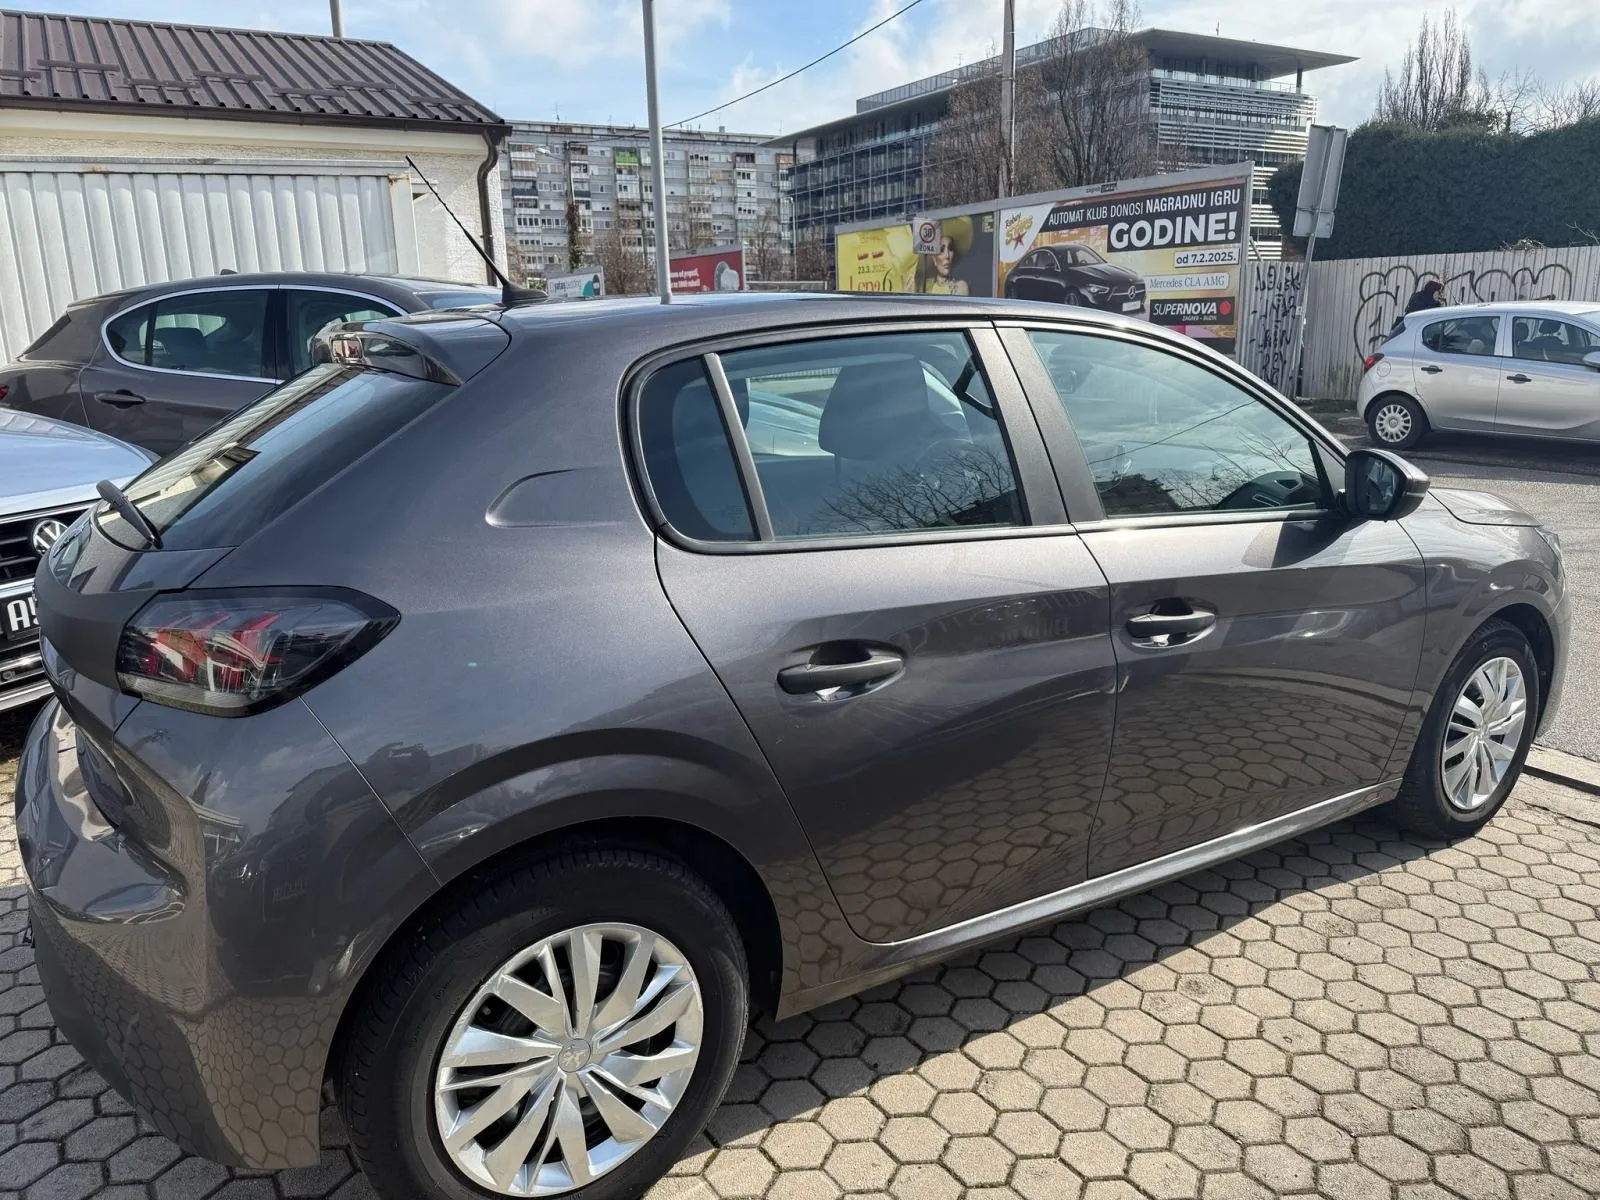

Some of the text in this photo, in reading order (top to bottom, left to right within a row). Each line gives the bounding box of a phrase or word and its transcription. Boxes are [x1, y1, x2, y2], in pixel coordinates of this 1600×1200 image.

[1048, 188, 1241, 226] AUTOMAT KLUB DONOSI NAGRADNU IGRU
[923, 228, 933, 238] 30
[1110, 211, 1238, 249] GODINE!
[919, 244, 935, 252] ZONA
[1176, 251, 1237, 264] od 7.2.2025.
[1149, 275, 1225, 289] Mercedes CLA AMG
[1153, 302, 1217, 316] SUPERNOVA
